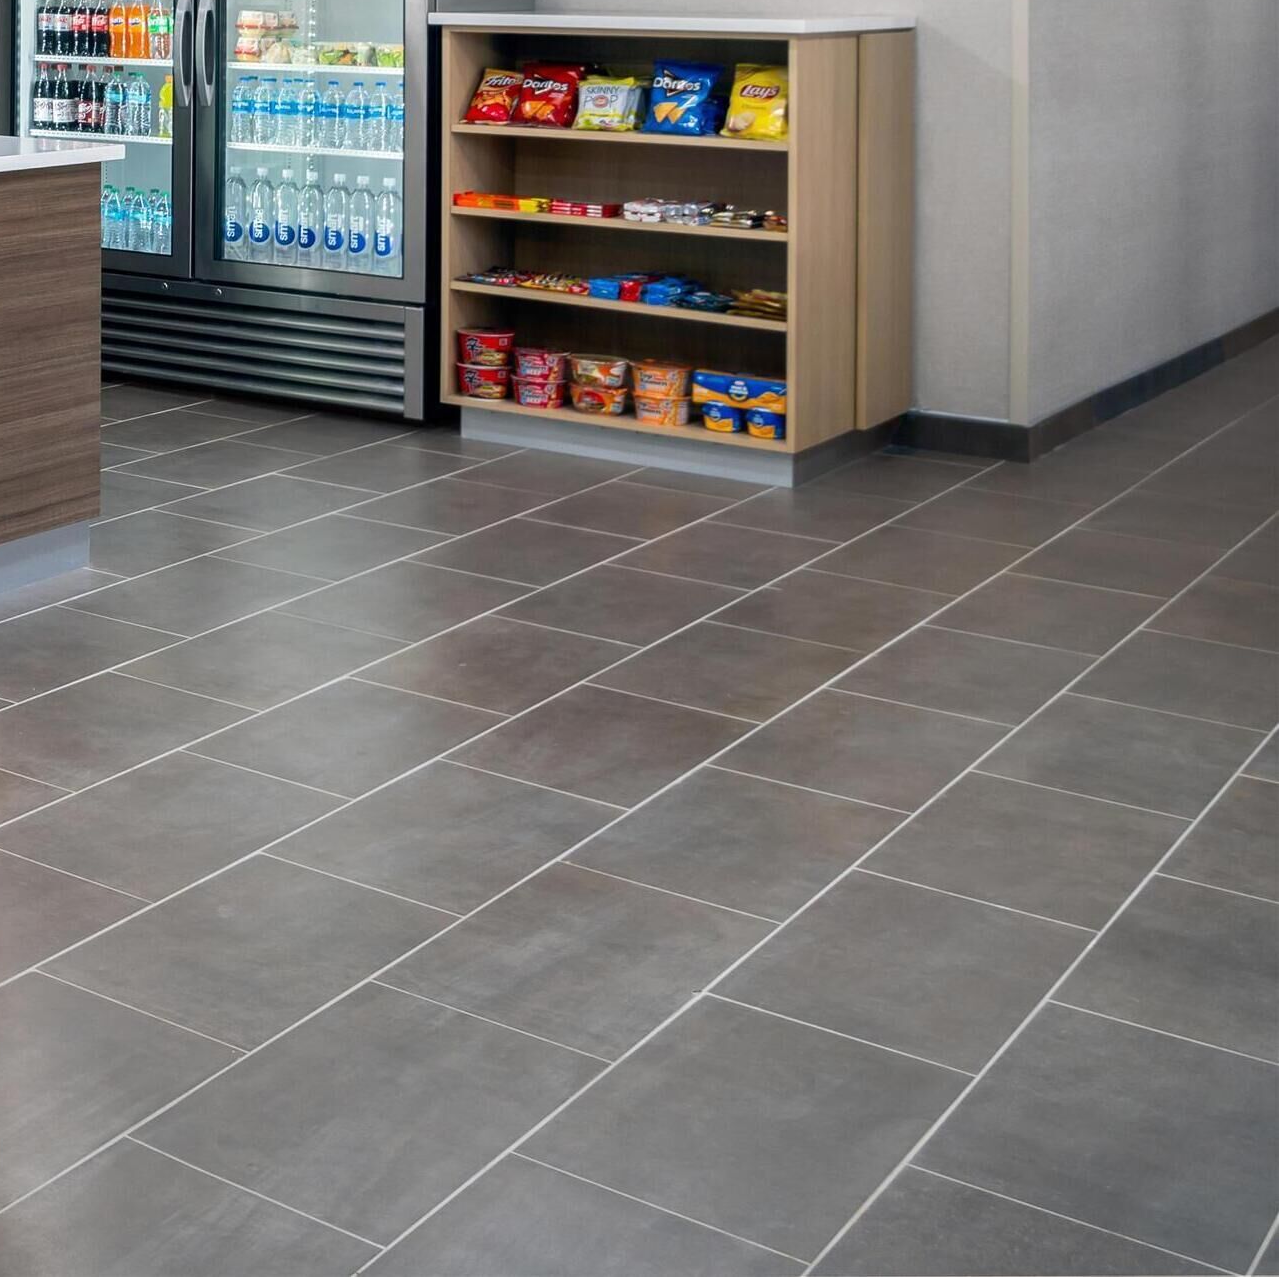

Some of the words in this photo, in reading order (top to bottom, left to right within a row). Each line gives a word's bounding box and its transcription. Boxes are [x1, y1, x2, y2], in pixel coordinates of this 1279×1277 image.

[523, 79, 569, 91] Doritos
[653, 77, 701, 91] Doritos
[586, 86, 620, 95] SKINNY
